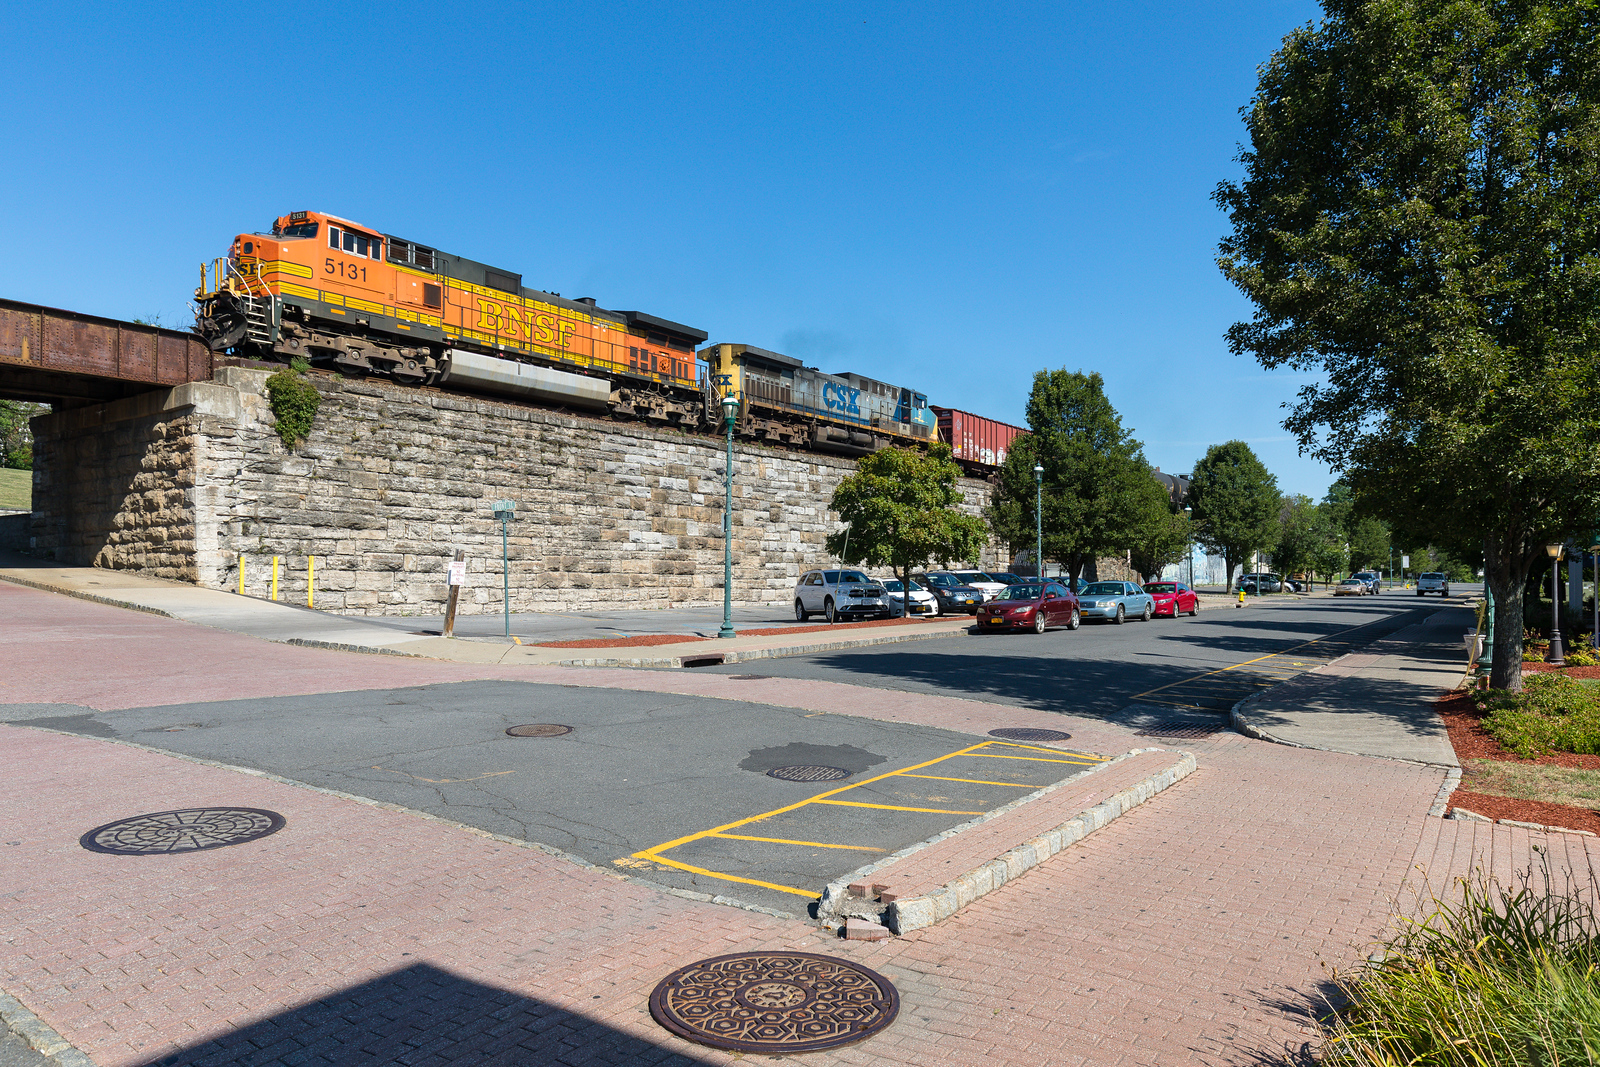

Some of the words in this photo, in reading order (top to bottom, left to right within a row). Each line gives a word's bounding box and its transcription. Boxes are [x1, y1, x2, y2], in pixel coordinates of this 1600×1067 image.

[292, 212, 305, 220] 5131
[325, 258, 367, 283] 5131
[477, 298, 577, 348] BNSF
[822, 381, 861, 415] CSX
